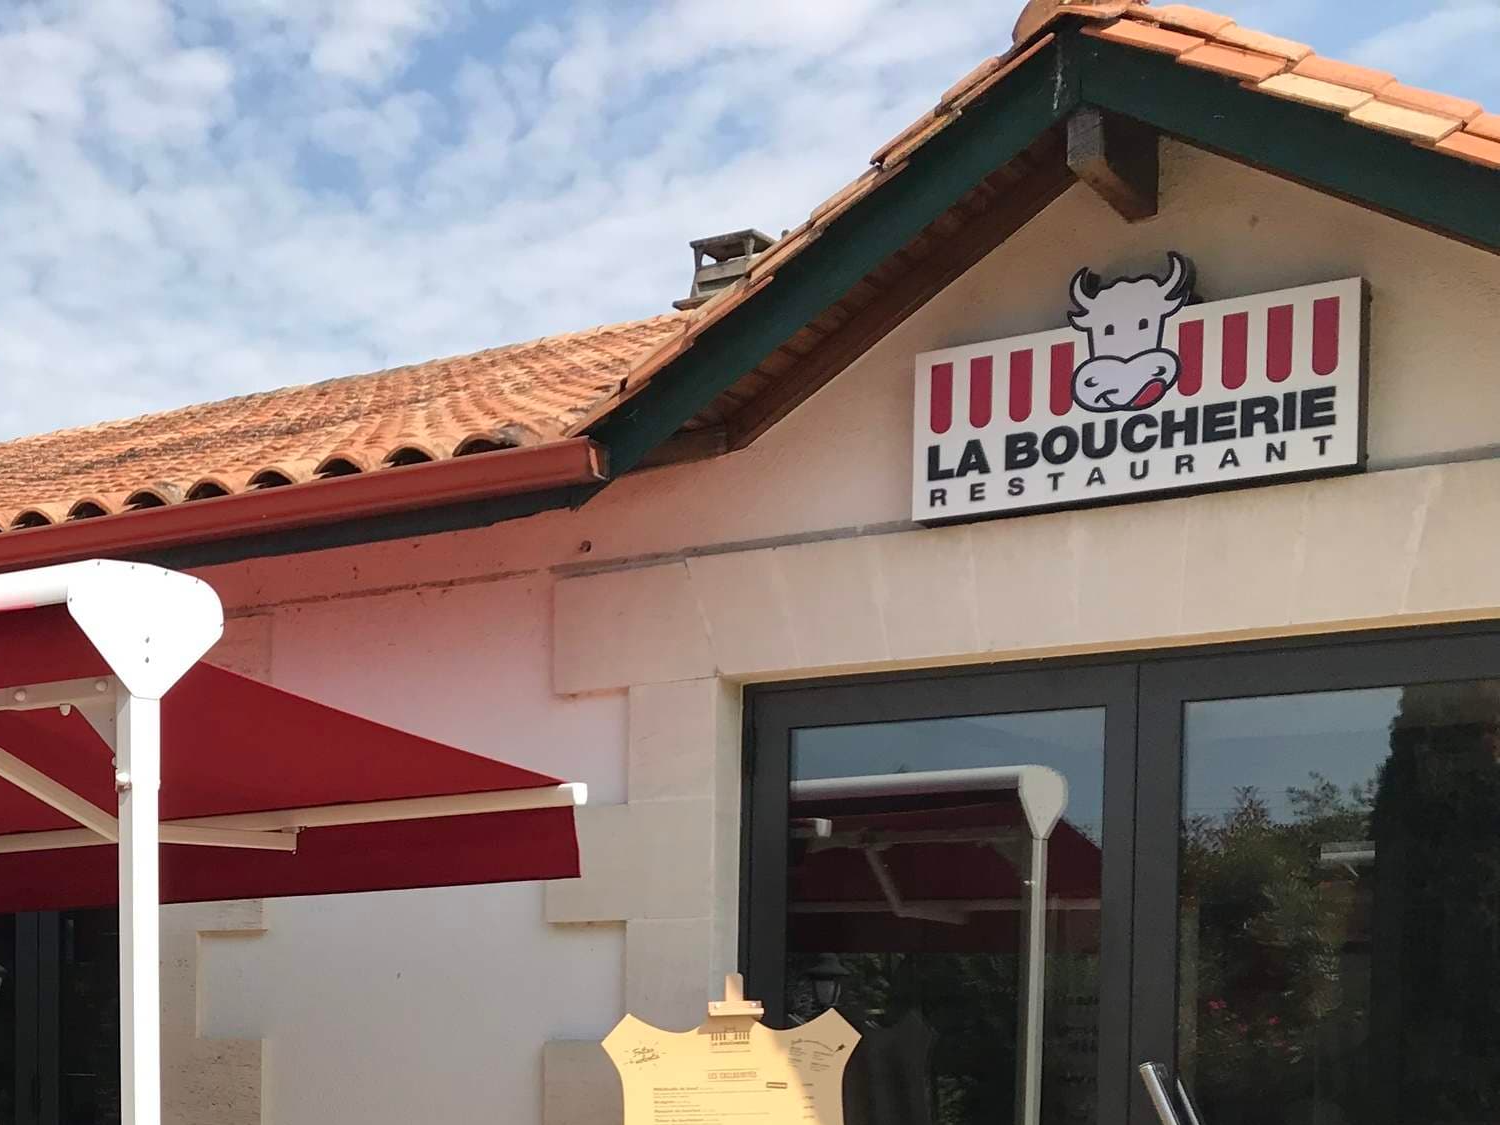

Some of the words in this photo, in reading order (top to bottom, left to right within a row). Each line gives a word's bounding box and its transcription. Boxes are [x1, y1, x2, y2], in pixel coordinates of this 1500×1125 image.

[927, 438, 990, 481] LA
[1004, 386, 1337, 471] BOUCHERIE
[930, 435, 1333, 507] RESTAURANT
